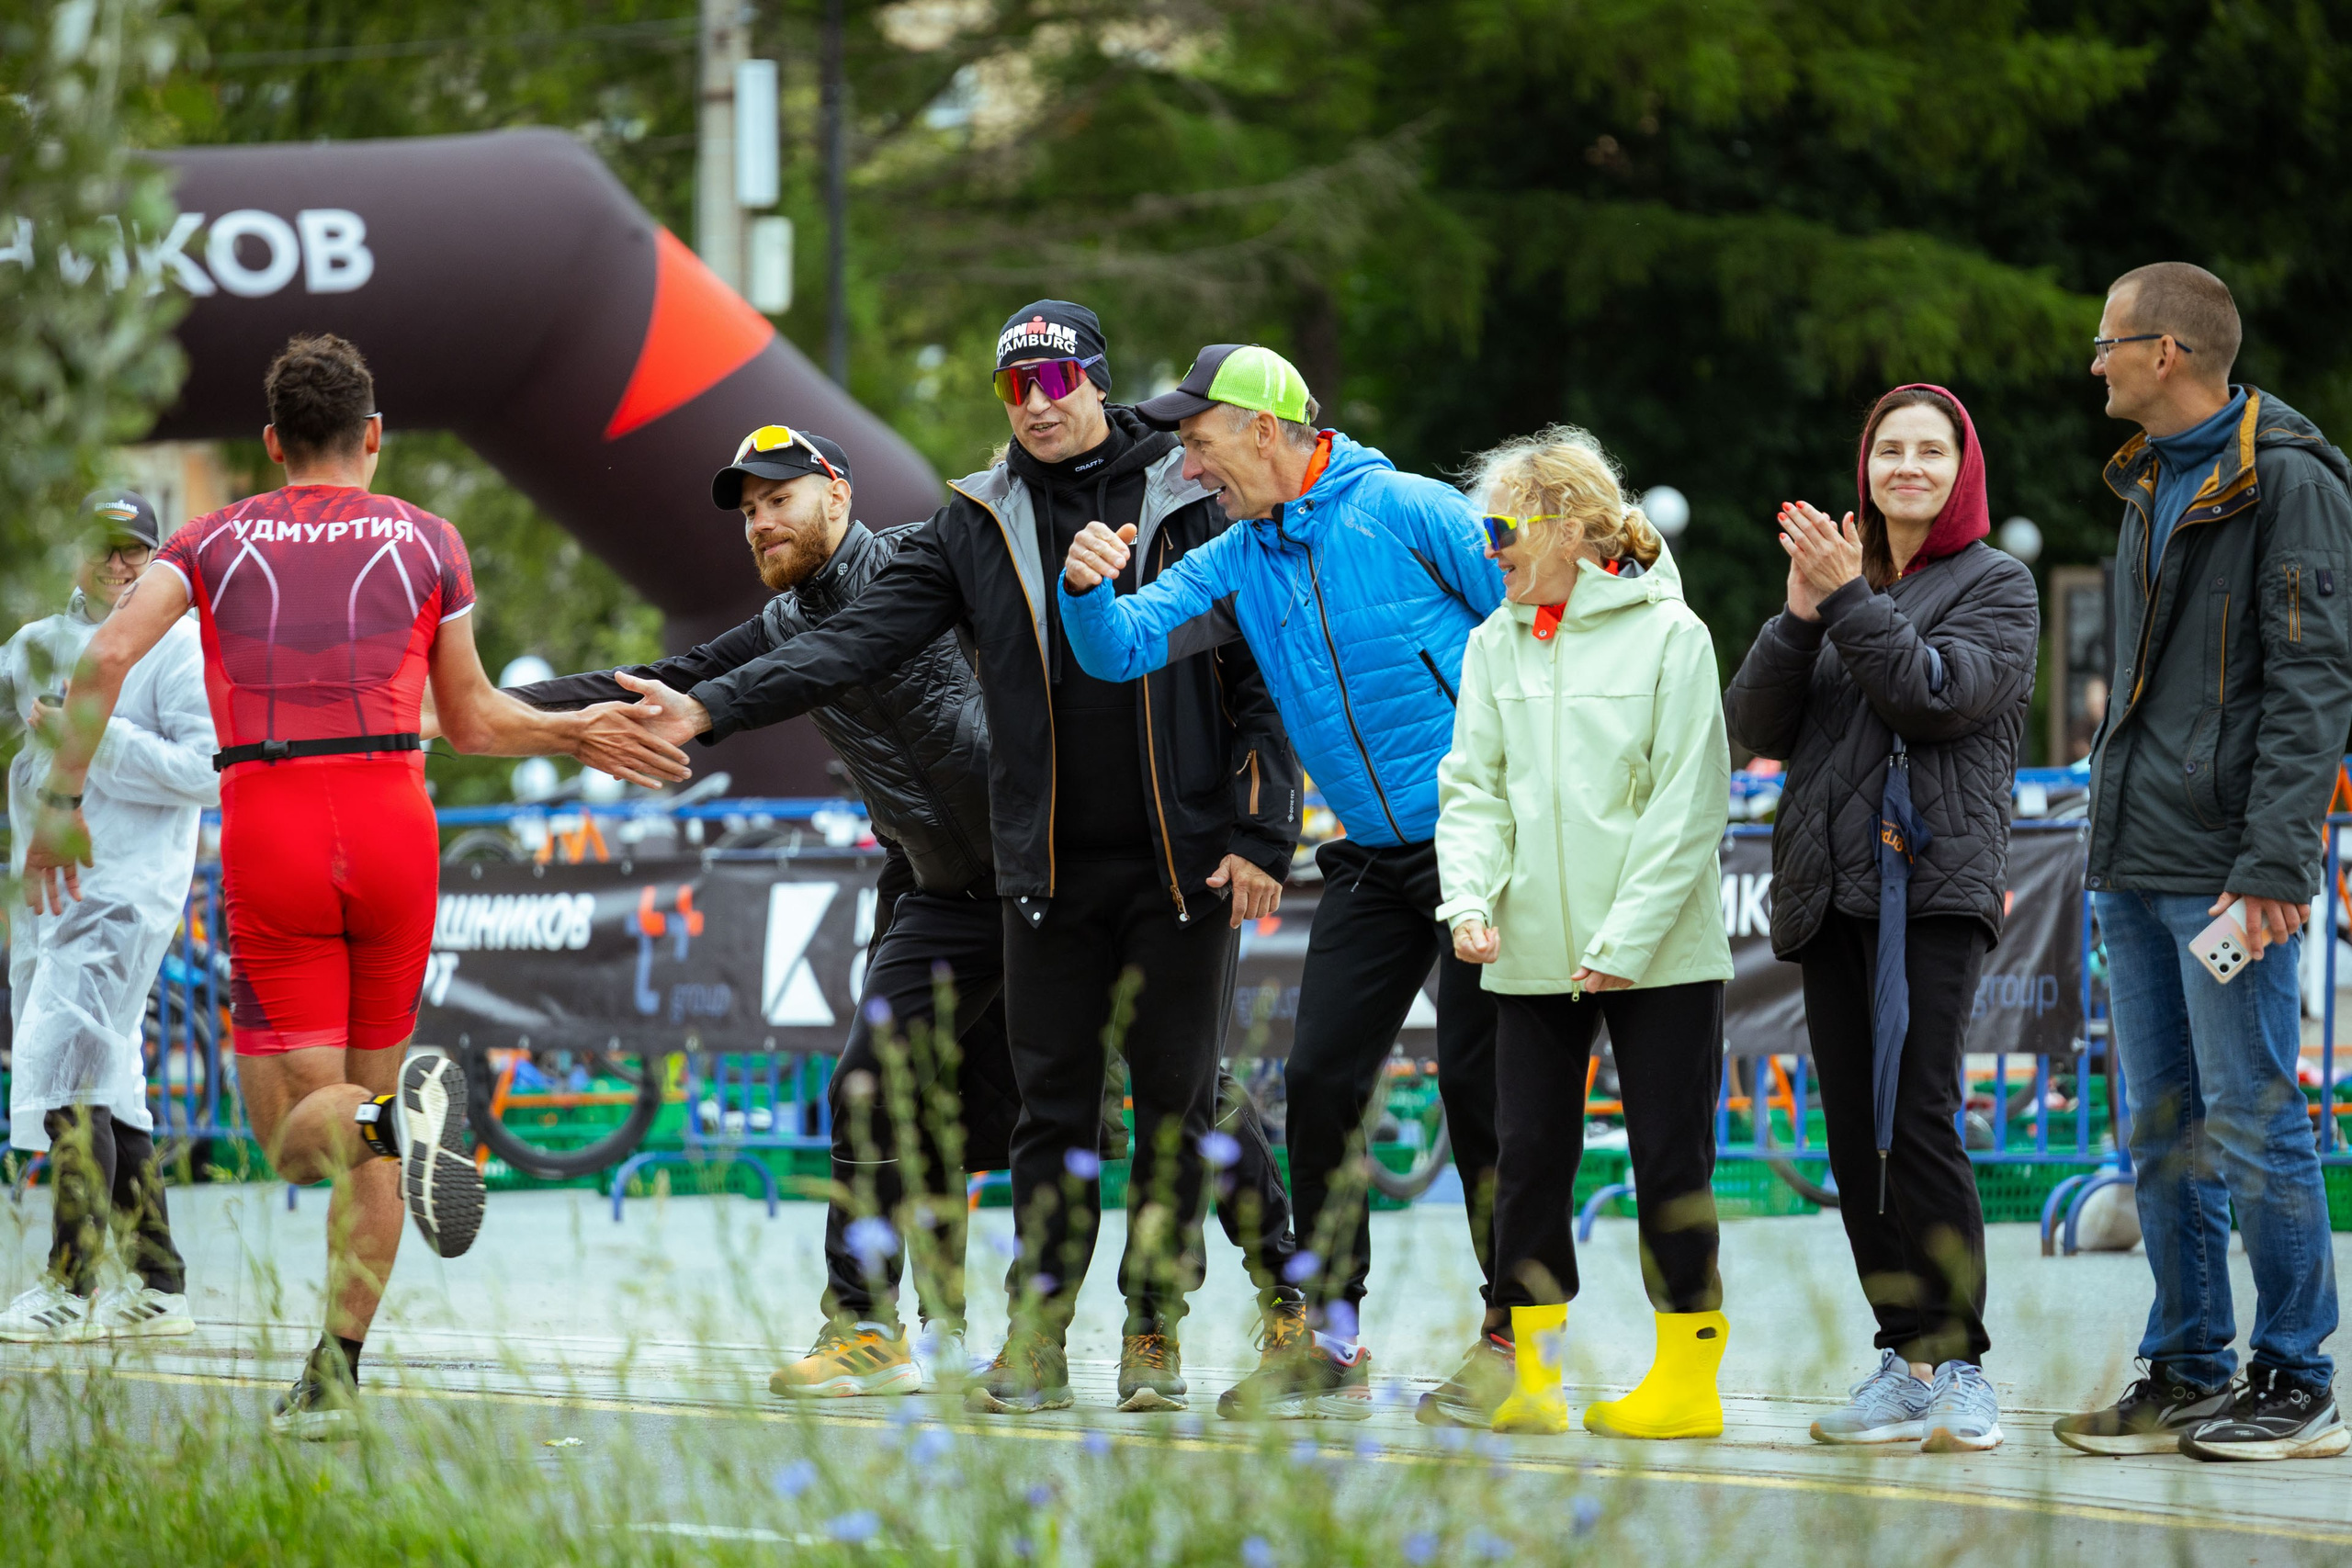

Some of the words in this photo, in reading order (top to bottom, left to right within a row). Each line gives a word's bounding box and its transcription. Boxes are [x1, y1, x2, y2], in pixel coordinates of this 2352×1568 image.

[996, 317, 1079, 356] IRONMAN
[998, 334, 1076, 359] HAMBURG
[1074, 460, 1099, 472] CRAFT
[232, 517, 413, 543] УДМУРТИЯ
